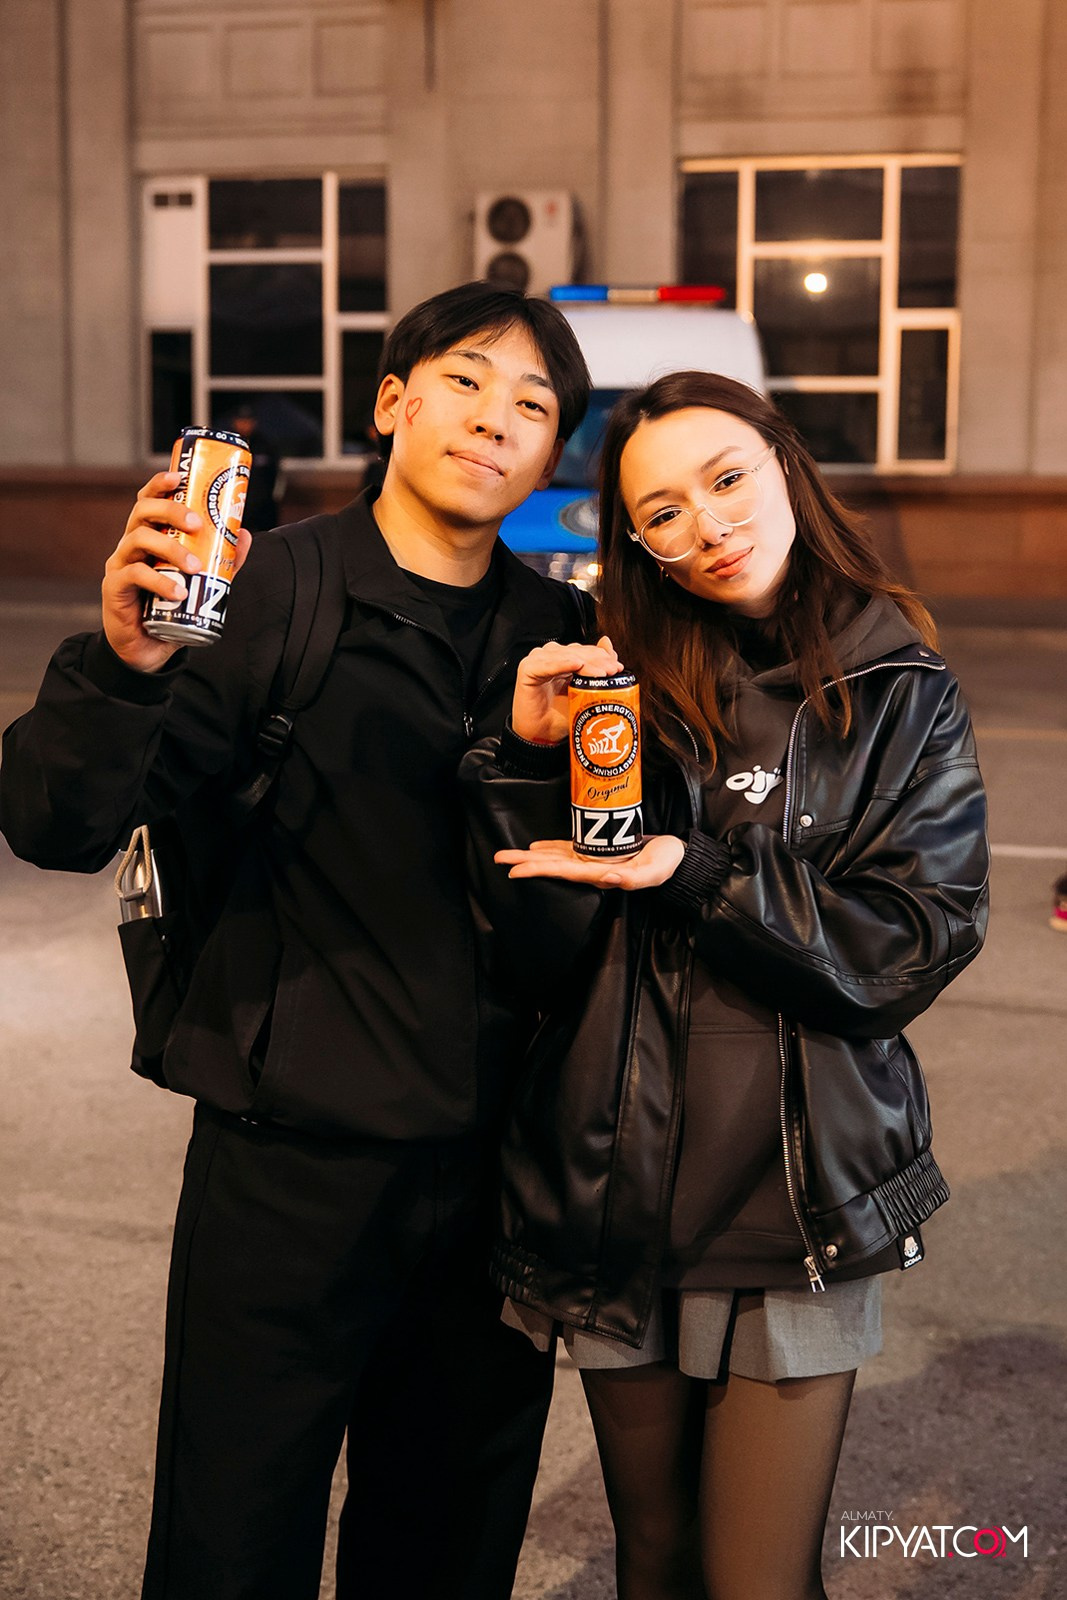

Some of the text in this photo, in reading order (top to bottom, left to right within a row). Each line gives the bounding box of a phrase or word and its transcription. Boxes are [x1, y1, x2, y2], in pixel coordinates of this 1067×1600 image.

[215, 432, 228, 440] GO
[589, 679, 609, 687] WORK
[587, 776, 630, 801] Original
